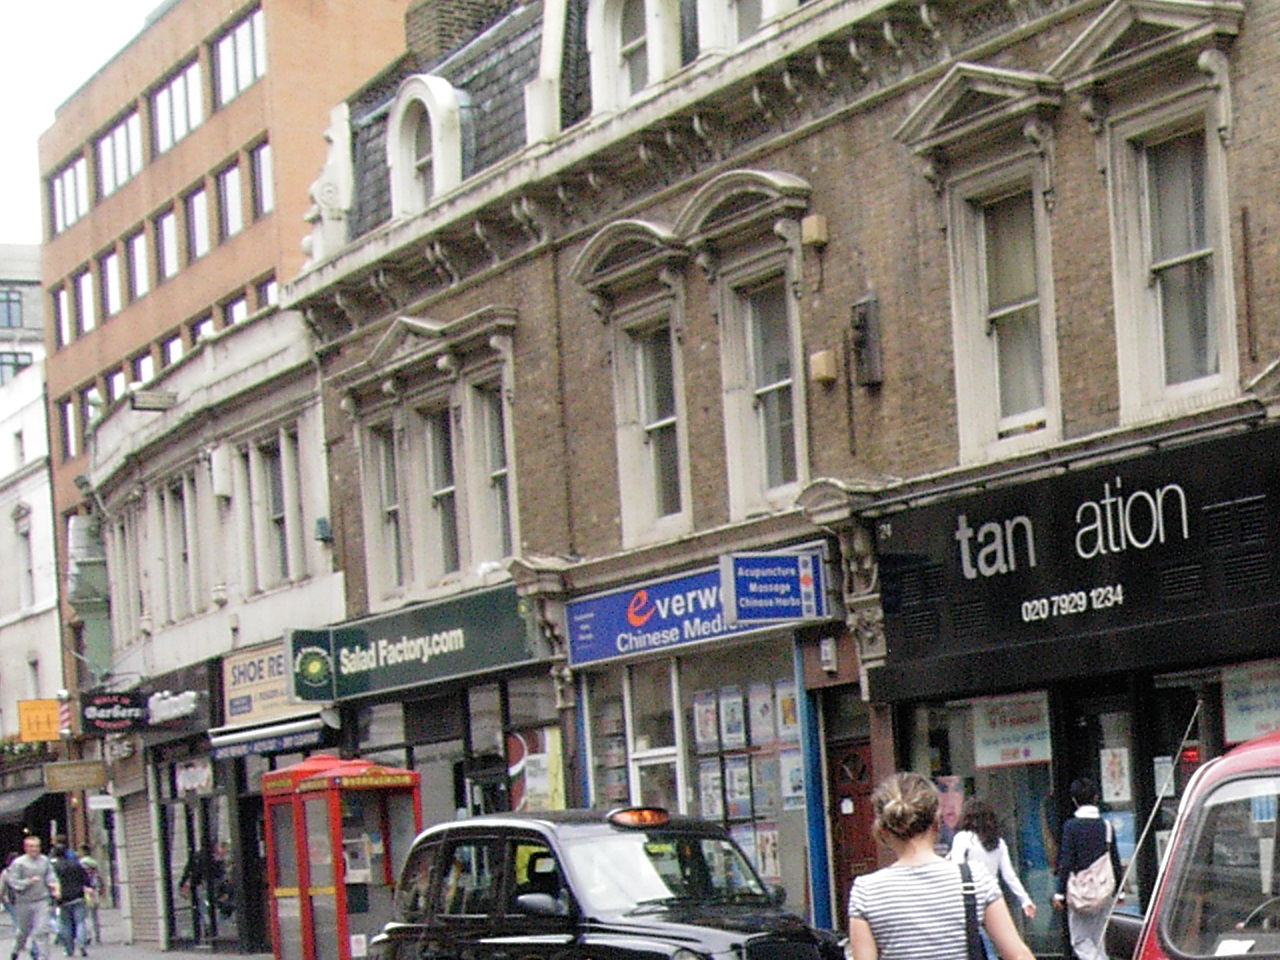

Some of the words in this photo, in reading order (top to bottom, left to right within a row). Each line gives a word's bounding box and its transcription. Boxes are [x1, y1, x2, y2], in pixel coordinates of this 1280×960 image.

[955, 515, 1036, 580] tan
[1075, 477, 1189, 560] ation
[738, 566, 797, 580] Acupuncture
[749, 582, 791, 595] Massage
[627, 585, 724, 627] everw
[739, 596, 774, 608] Chinese
[1021, 598, 1049, 622] 020
[1052, 591, 1087, 616] 7929
[1090, 584, 1124, 611] 1234
[339, 642, 377, 675] Salad
[378, 627, 465, 667] Factory.com
[616, 630, 680, 653] Chinese
[684, 613, 746, 639] Med
[231, 659, 265, 687] SHOE
